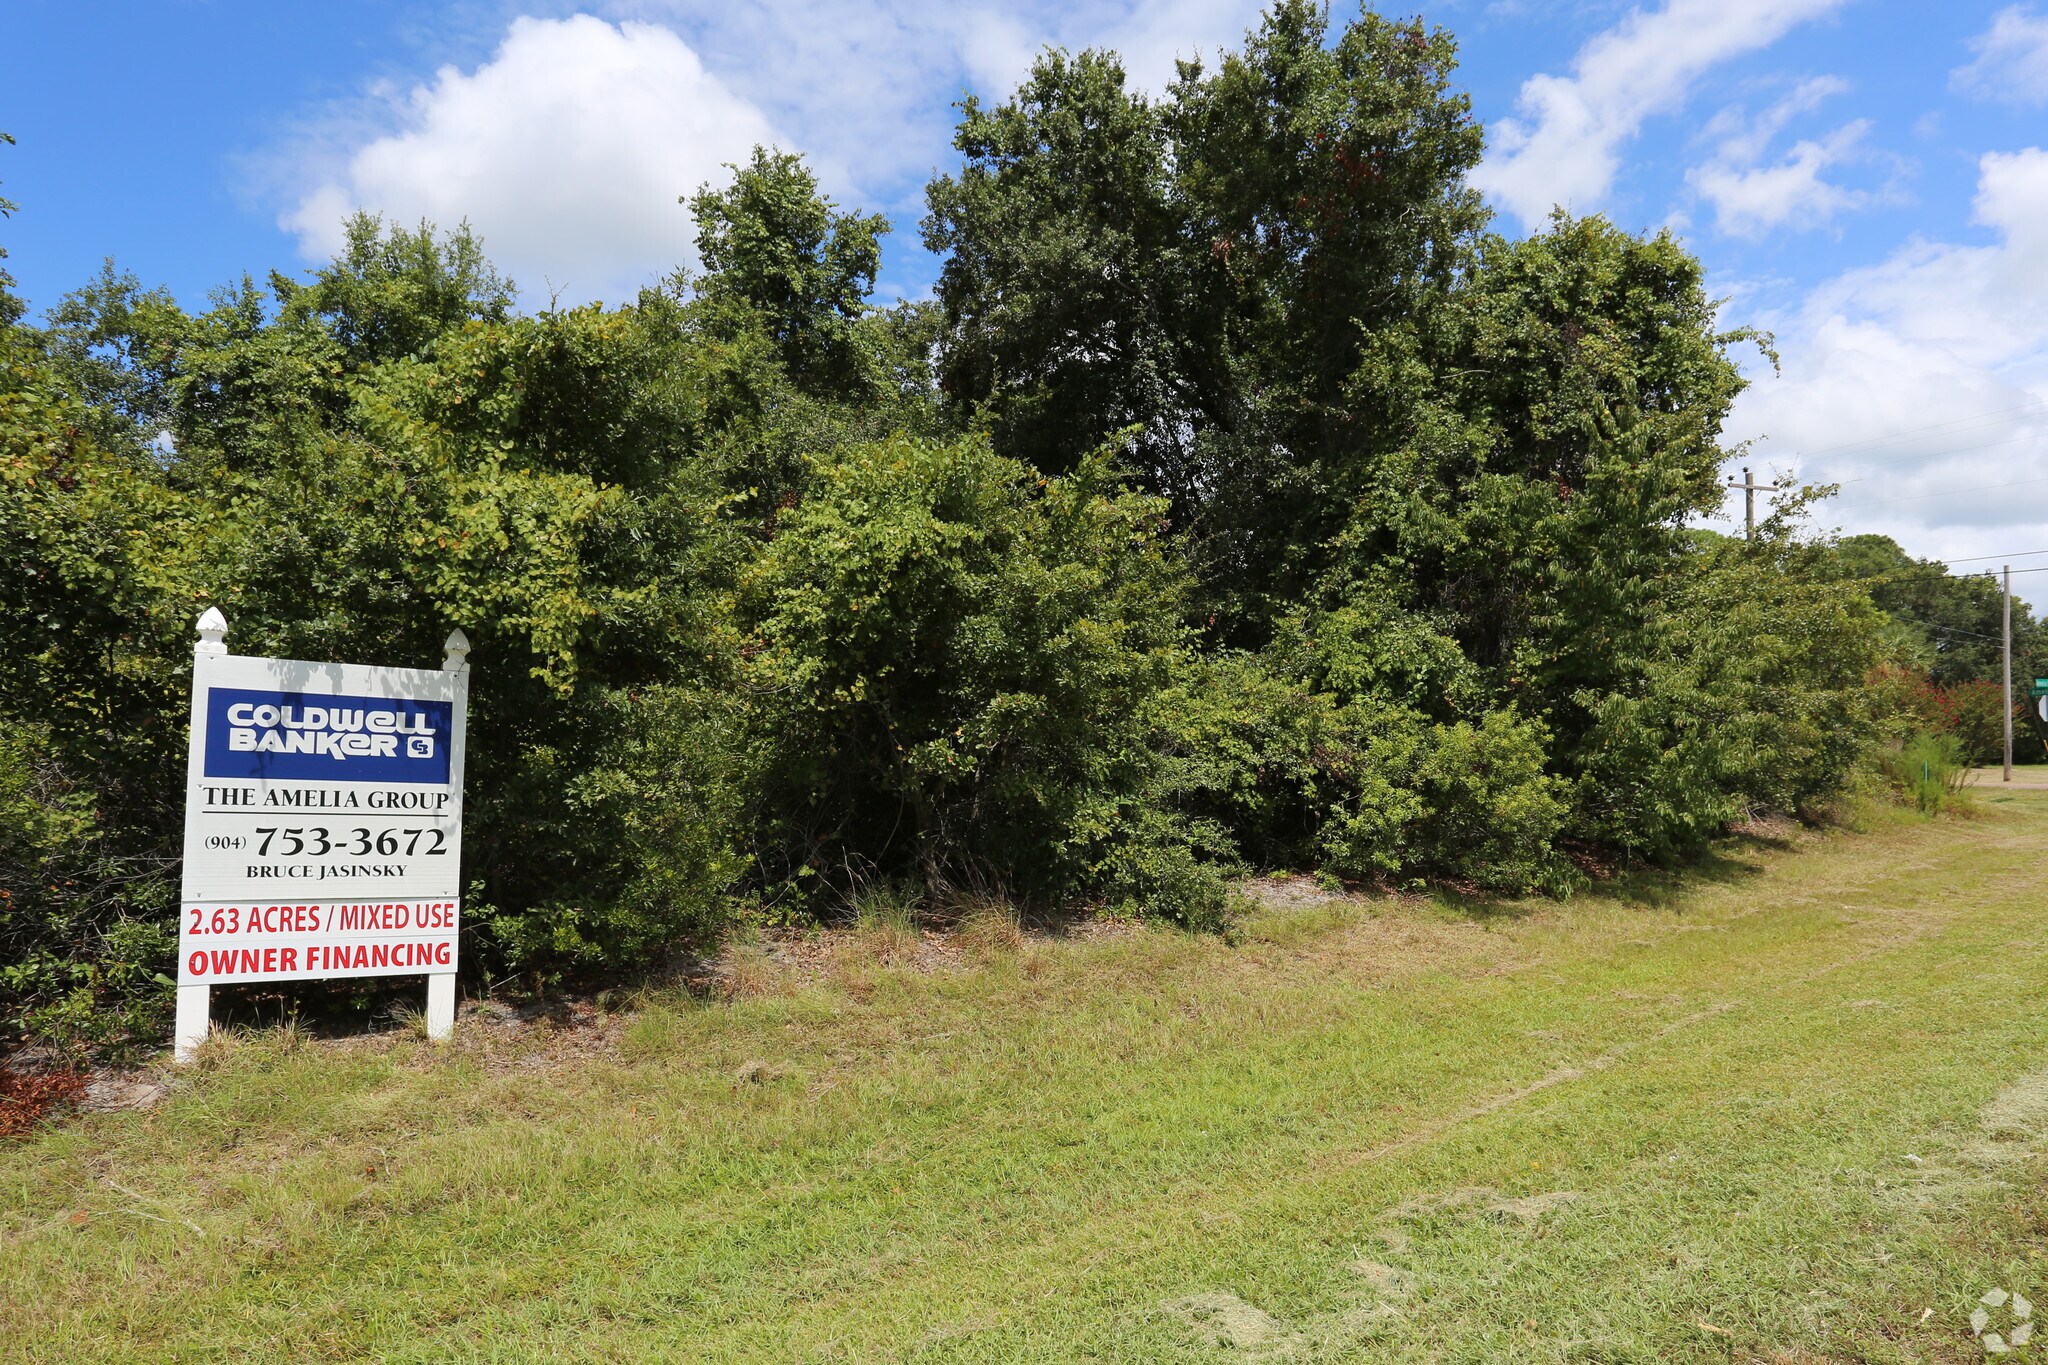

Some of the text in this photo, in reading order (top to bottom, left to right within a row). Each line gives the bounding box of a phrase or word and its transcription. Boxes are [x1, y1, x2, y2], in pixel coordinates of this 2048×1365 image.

[227, 702, 436, 735] COLDWELL
[228, 727, 397, 761] BANKER
[203, 786, 449, 810] THE AMELIA GROUP
[204, 827, 447, 857] (904) 753-3672
[246, 864, 407, 880] BRUCE JASINSKY
[188, 903, 455, 935] 2.63 ACRES / MIXED USE
[188, 941, 451, 977] OWNER FINANCING
